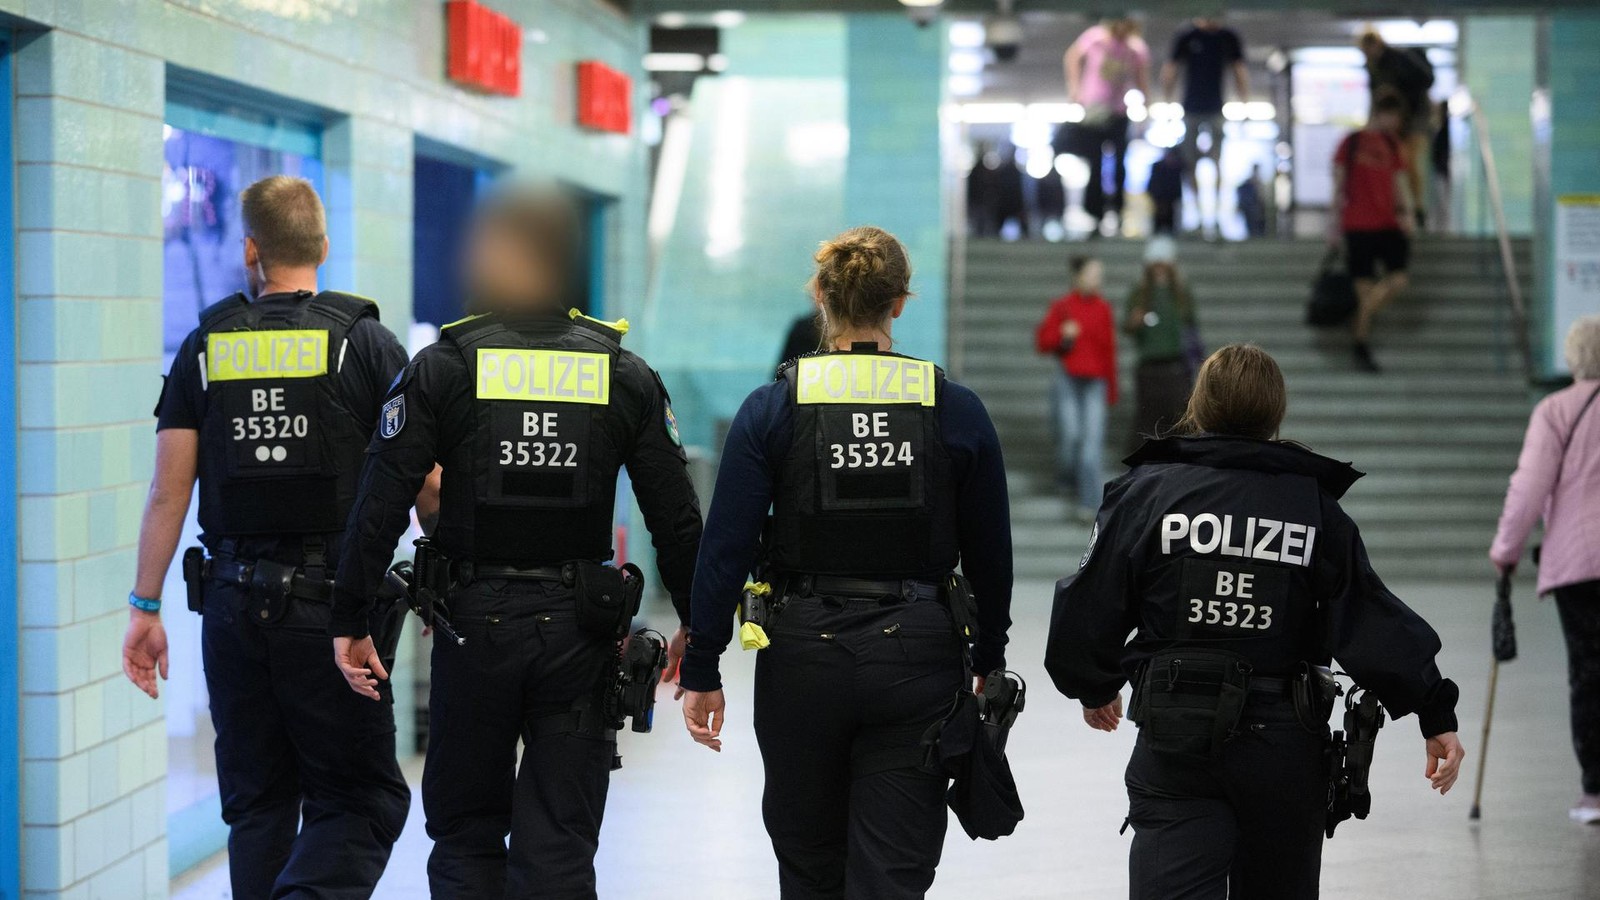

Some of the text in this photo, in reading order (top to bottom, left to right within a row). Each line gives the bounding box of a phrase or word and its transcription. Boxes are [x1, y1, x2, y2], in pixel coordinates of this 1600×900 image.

[213, 337, 322, 375] POLIZEI
[481, 353, 604, 400] POLIZEI
[802, 359, 929, 402] POLIZEI
[252, 388, 286, 412] BE
[232, 414, 309, 441] 35320
[522, 411, 558, 437] BE
[852, 412, 890, 438] BE
[499, 440, 578, 467] 35322
[830, 441, 914, 469] 35324
[1161, 513, 1316, 567] POLIZEI
[1215, 570, 1255, 599] BE
[1188, 598, 1273, 630] 35323
